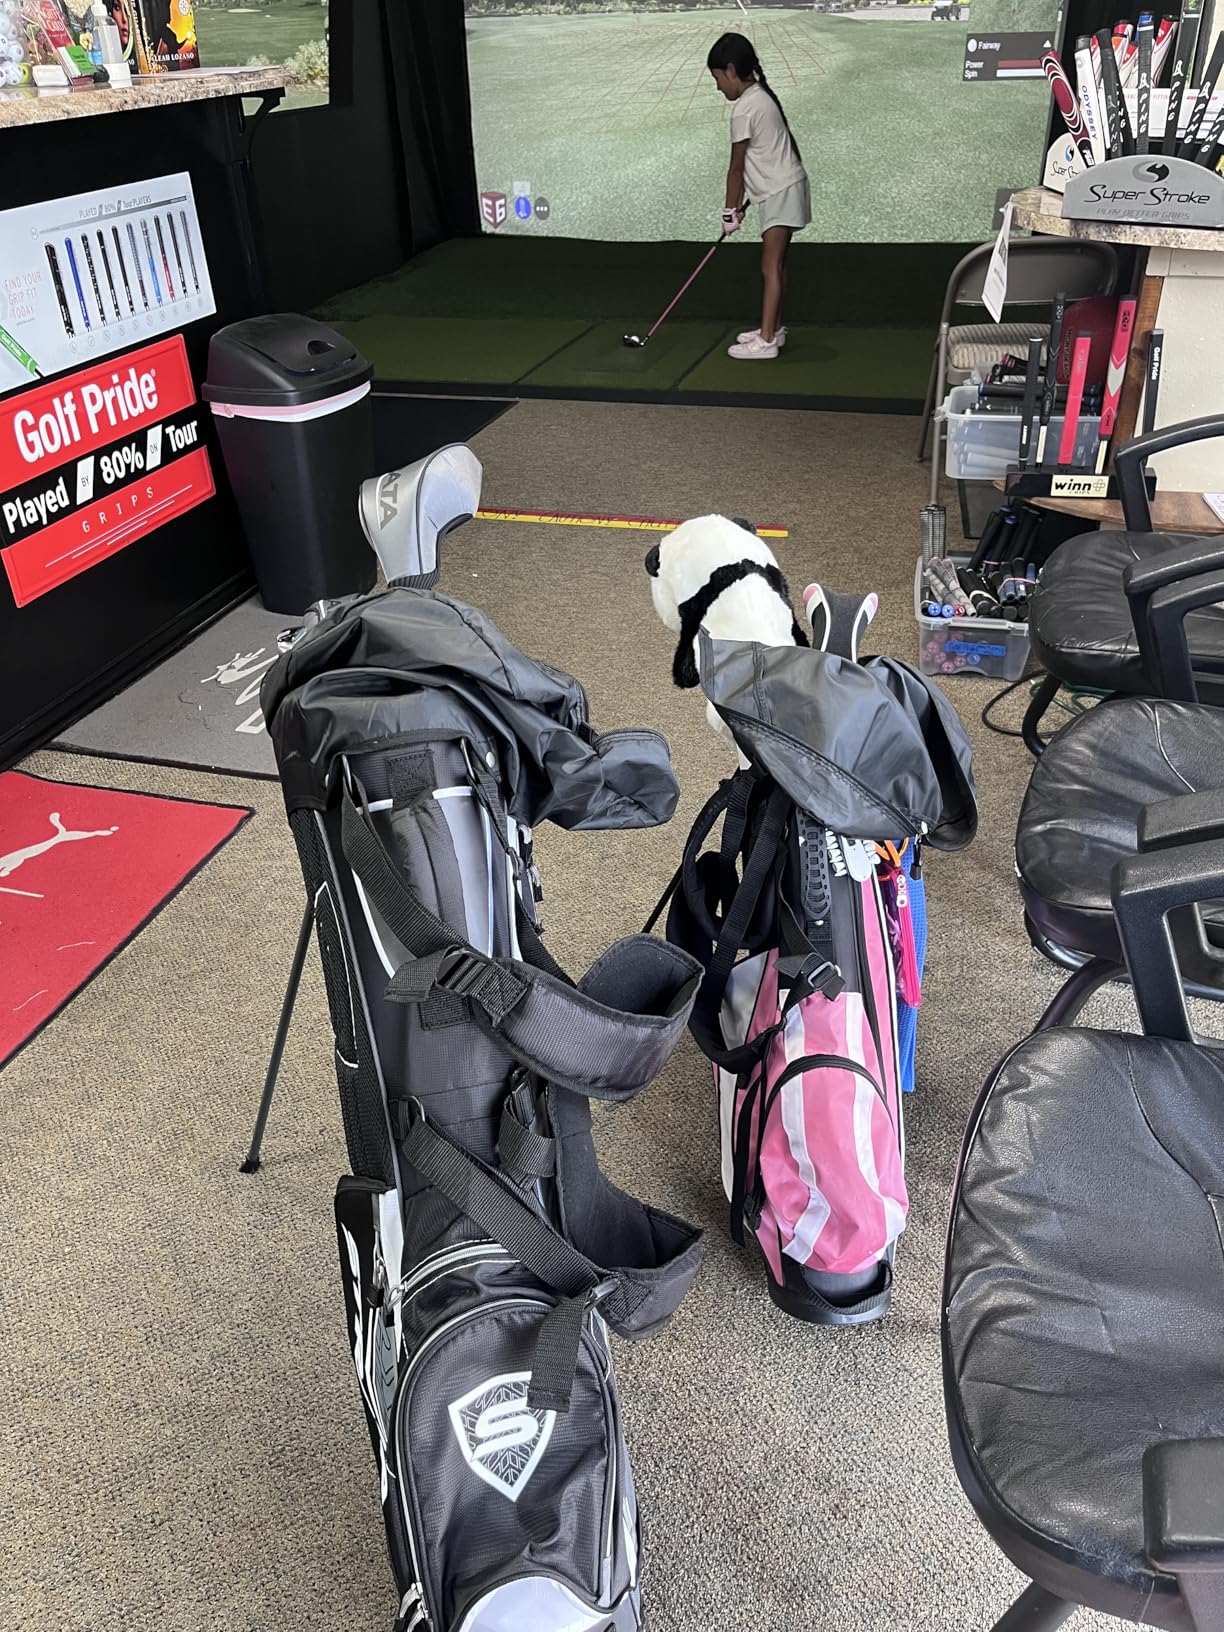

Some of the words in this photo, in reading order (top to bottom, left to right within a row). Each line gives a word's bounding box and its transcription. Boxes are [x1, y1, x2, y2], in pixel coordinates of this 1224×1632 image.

[978, 41, 1001, 51] Fairway
[155, 54, 170, 62] LEAH
[171, 52, 194, 61] LOZANO
[965, 60, 984, 69] Power
[964, 69, 978, 80] Spin
[1167, 81, 1180, 120] PING
[1081, 85, 1098, 140] ODYSSEY
[1139, 93, 1148, 133] PING
[1184, 103, 1206, 144] PING
[1109, 113, 1119, 153] PING
[133, 195, 151, 207] PLAYERS
[1084, 184, 1146, 203] Super
[1144, 187, 1211, 206] Stroke
[1097, 207, 1121, 216] PLAY
[1123, 208, 1160, 218] BETTER
[1161, 211, 1190, 220] GRIPS
[5, 275, 21, 289] FIND
[23, 271, 41, 286] YOUR
[9, 291, 24, 305] GRIP
[26, 288, 37, 299] FIT
[12, 305, 34, 320] TODAY
[1153, 347, 1161, 360] Golf
[1151, 361, 1160, 381] Pride
[14, 391, 81, 463] Golf
[2, 476, 70, 534] Played
[81, 475, 90, 487] BY
[100, 442, 145, 485] 80%
[150, 443, 158, 454] ON
[165, 420, 198, 452] Tour
[1055, 478, 1092, 491] winn
[82, 486, 153, 533] GRIPS
